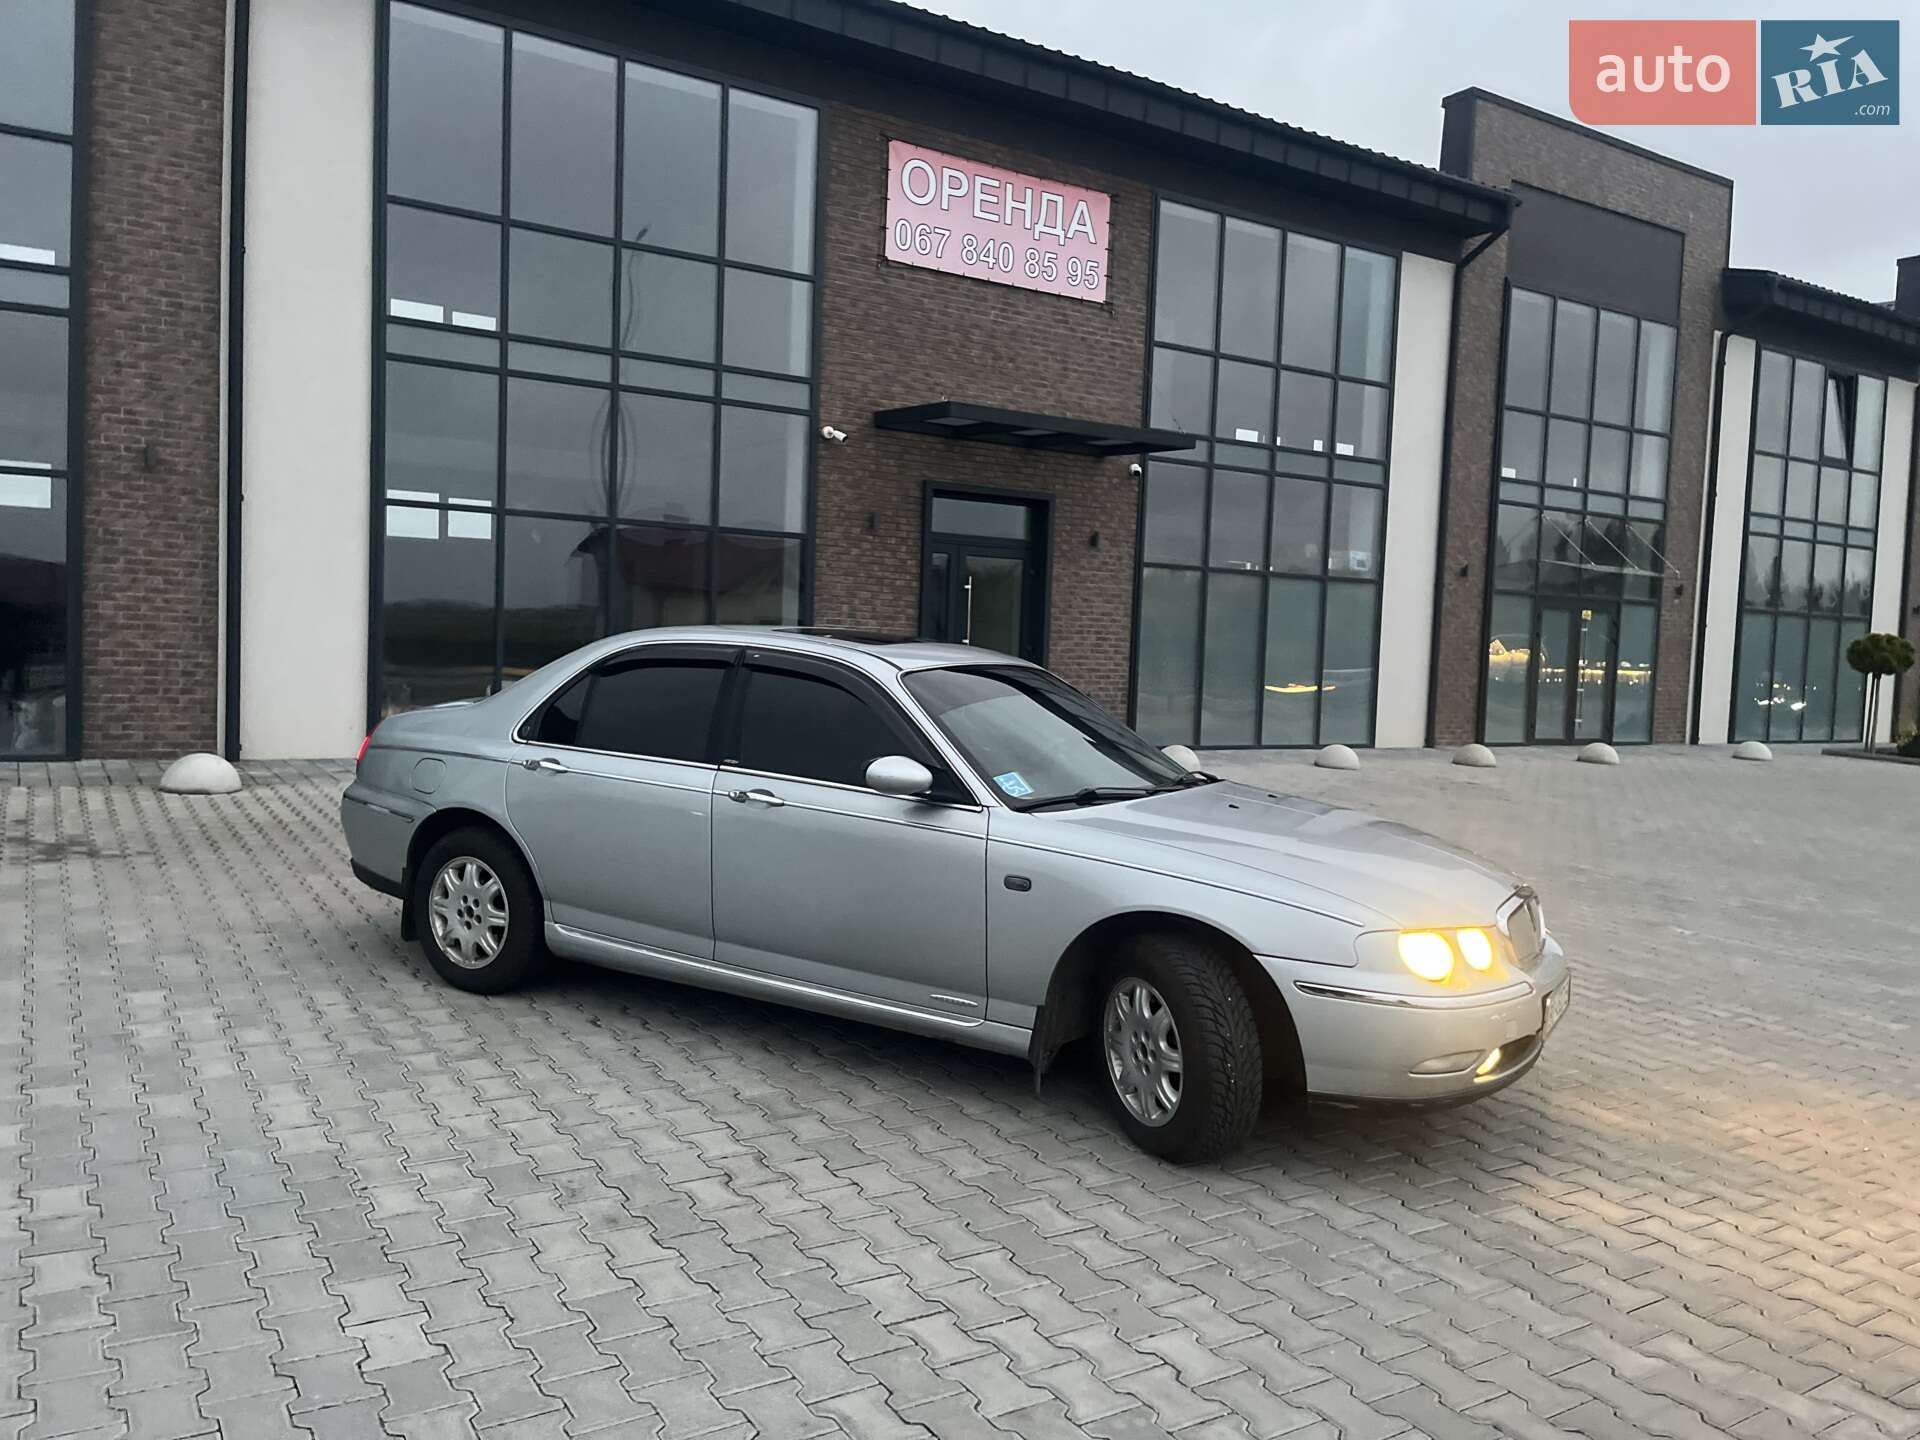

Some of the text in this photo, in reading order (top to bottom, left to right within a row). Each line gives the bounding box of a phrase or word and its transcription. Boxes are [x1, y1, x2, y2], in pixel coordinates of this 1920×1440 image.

[901, 158, 1097, 246] ОРЕНДА
[895, 219, 1099, 290] 067 840 85 95
